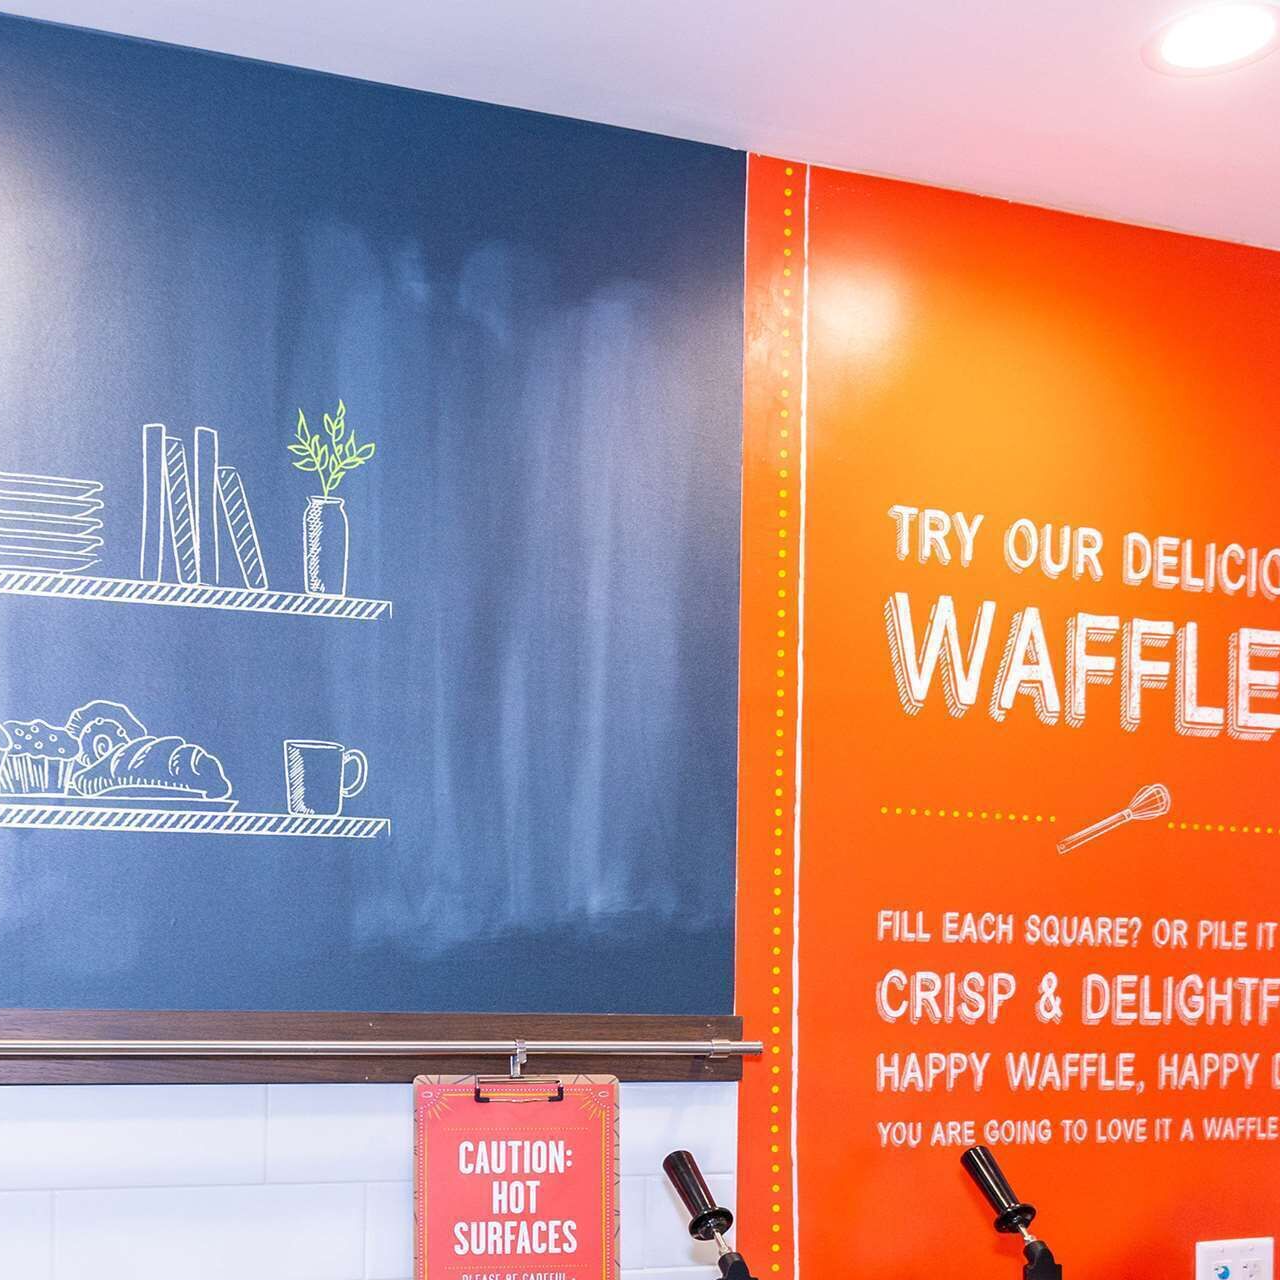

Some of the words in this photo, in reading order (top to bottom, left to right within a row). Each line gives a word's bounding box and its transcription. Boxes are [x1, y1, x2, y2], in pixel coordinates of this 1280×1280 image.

[888, 504, 984, 566] TRY
[1004, 517, 1103, 581] OUR
[876, 909, 932, 943] FILL
[941, 911, 1014, 944] EACH
[1024, 914, 1143, 948] SQUARE?
[1152, 917, 1188, 949] OR
[1197, 919, 1248, 951] PILE
[1255, 921, 1278, 951] IT
[876, 968, 1017, 1026] CRISP
[1036, 970, 1063, 1026] &
[876, 1051, 991, 1092] HAPPY
[1006, 1051, 1146, 1096] WAFFLE,
[1157, 1052, 1260, 1090] HAPPY
[876, 1120, 923, 1149] YOU
[930, 1119, 976, 1147] ARE
[983, 1118, 1053, 1146] GOING
[1060, 1118, 1088, 1142] TO
[1095, 1117, 1148, 1144] LOVE
[1154, 1117, 1172, 1141] IT
[1180, 1117, 1195, 1140] A
[1202, 1116, 1279, 1139] WAFFLE
[458, 1140, 573, 1175] CAUTION:
[492, 1180, 541, 1214] HOT
[453, 1219, 578, 1255] SURFACES
